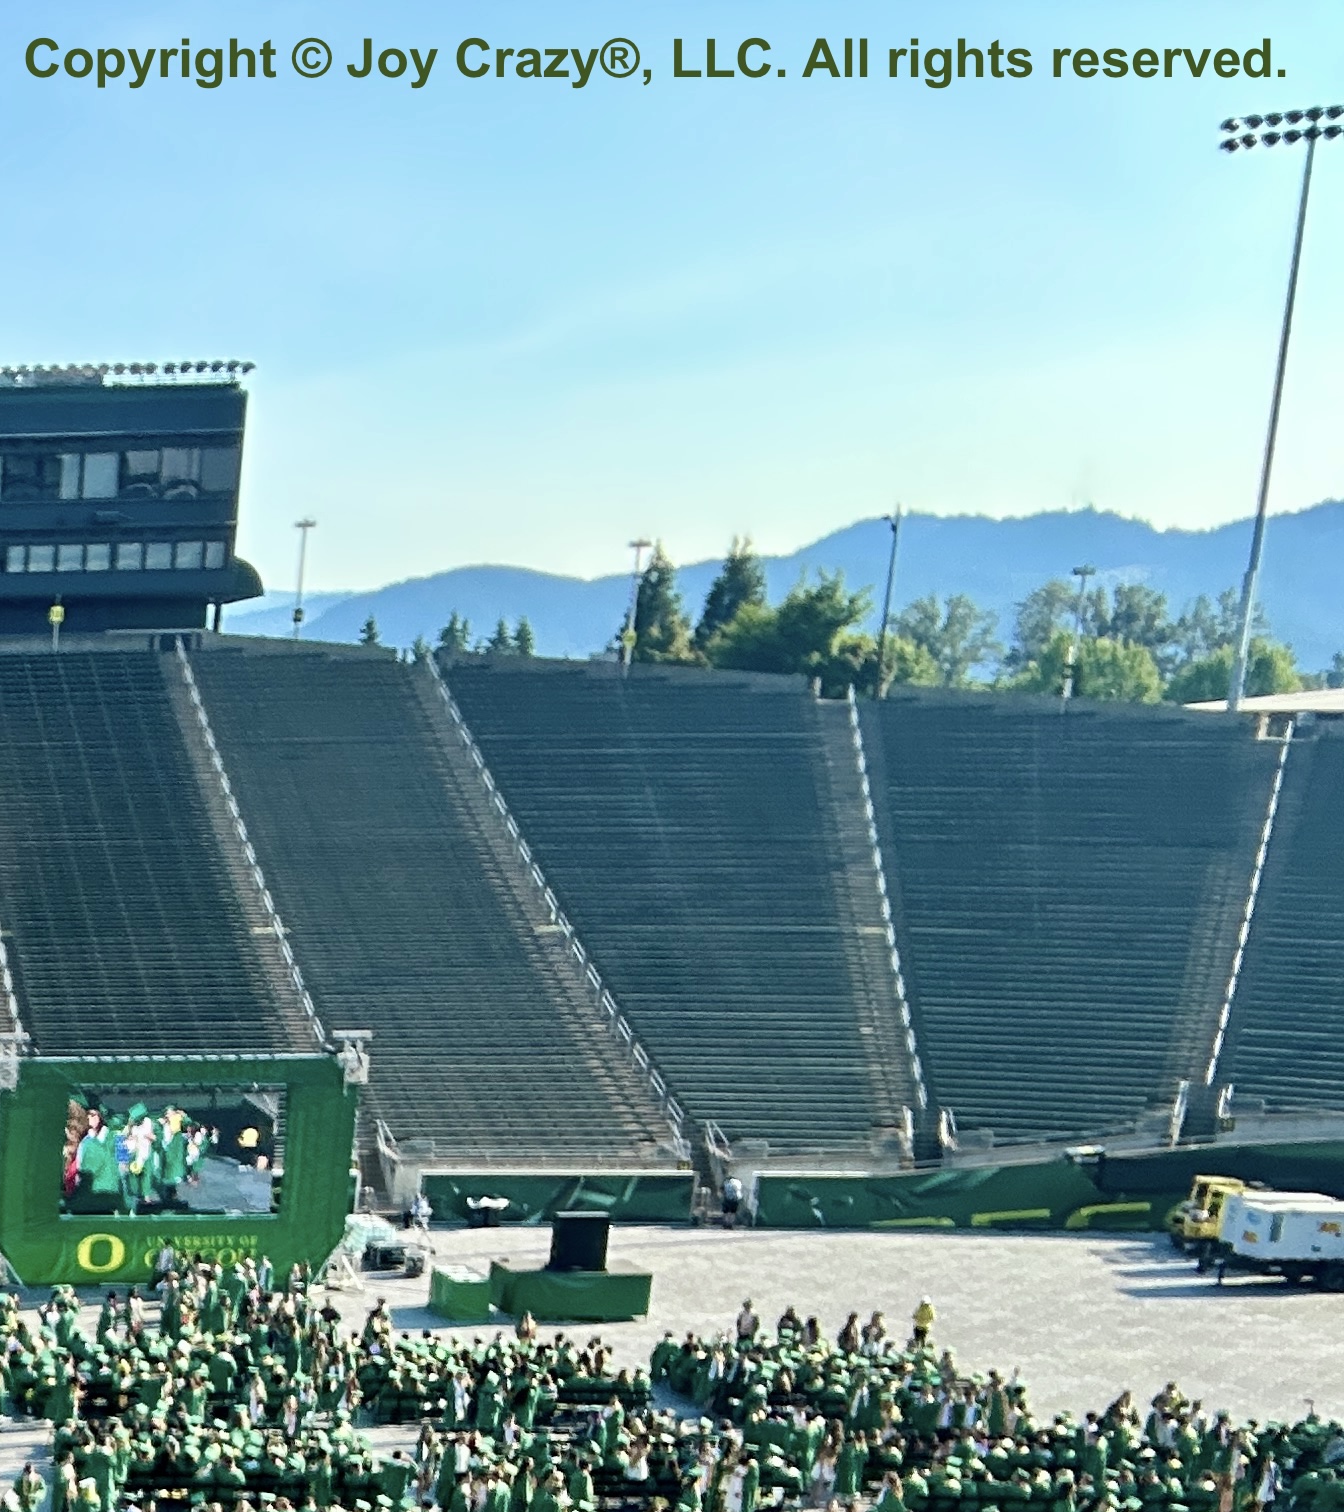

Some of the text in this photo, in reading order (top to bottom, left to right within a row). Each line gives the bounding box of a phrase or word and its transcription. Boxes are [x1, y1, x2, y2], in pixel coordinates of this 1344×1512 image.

[77, 1233, 125, 1273] O
[146, 1234, 258, 1247] UNVERSITY OF
